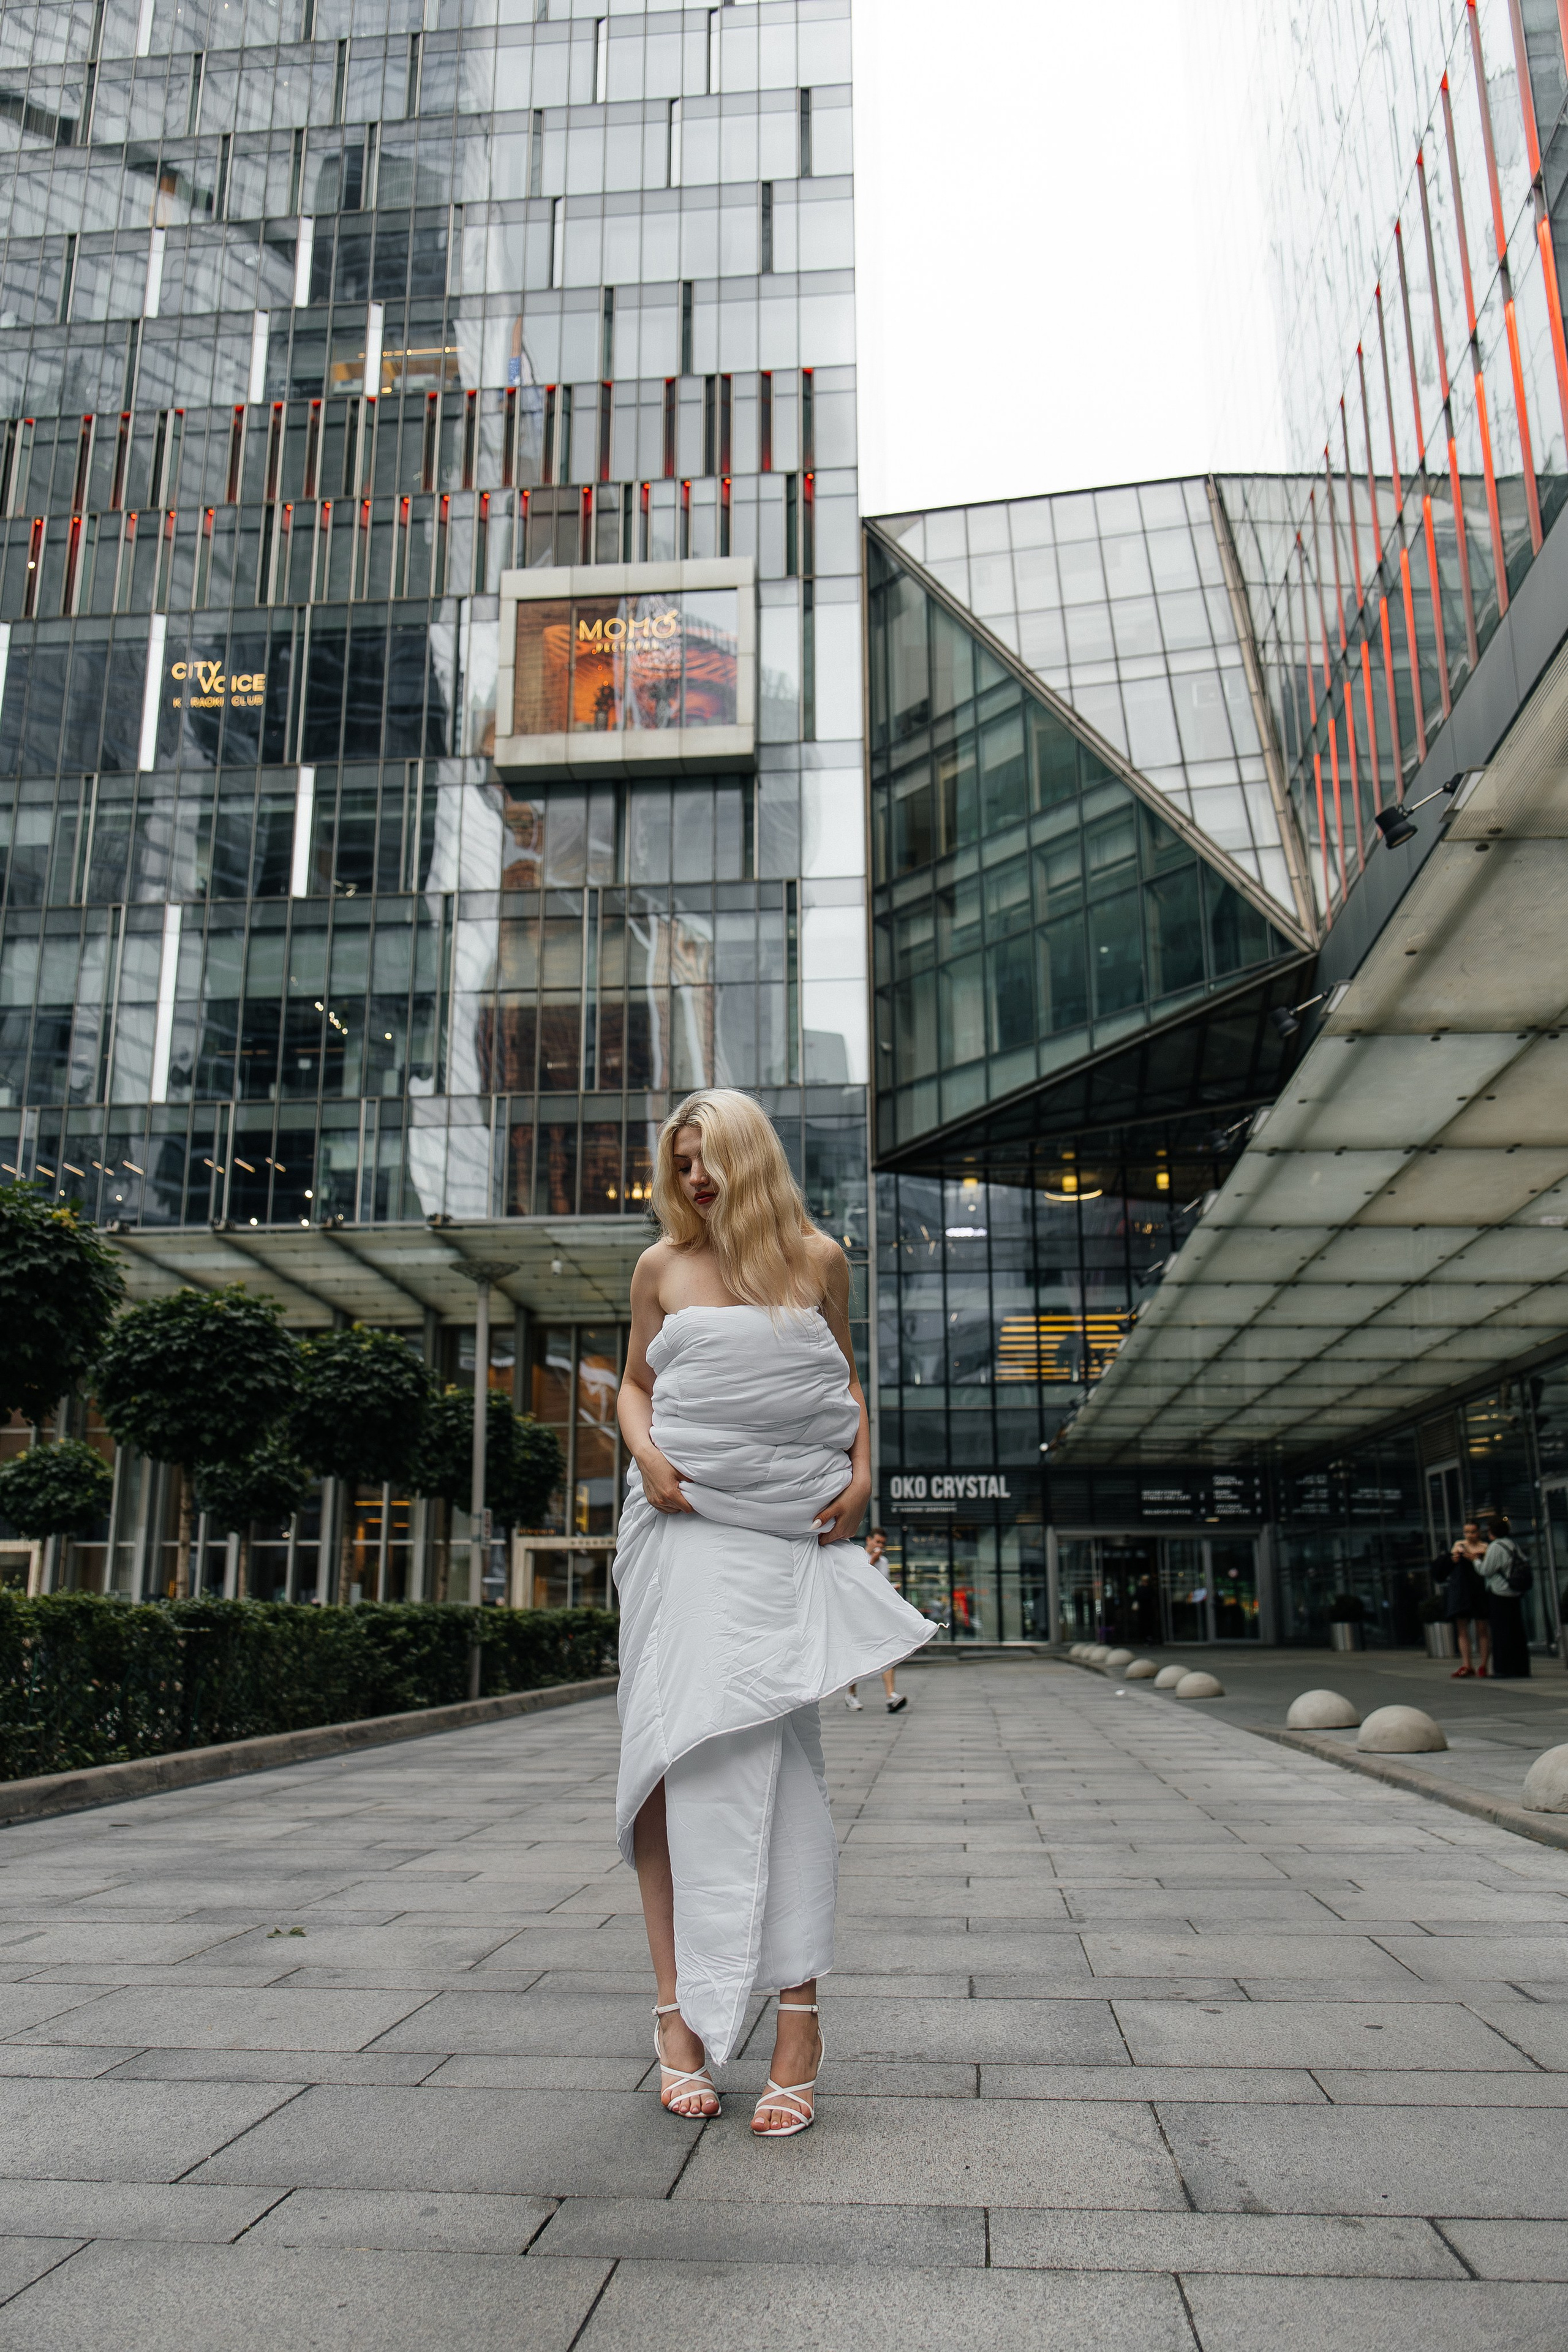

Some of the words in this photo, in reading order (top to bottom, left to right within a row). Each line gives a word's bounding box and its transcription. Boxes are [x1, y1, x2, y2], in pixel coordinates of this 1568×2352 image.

[579, 609, 678, 641] MOMO
[171, 661, 222, 680] CITY
[232, 695, 263, 707] CLUB
[891, 1476, 927, 1499] OKO
[931, 1475, 1011, 1498] CRYSTAL
